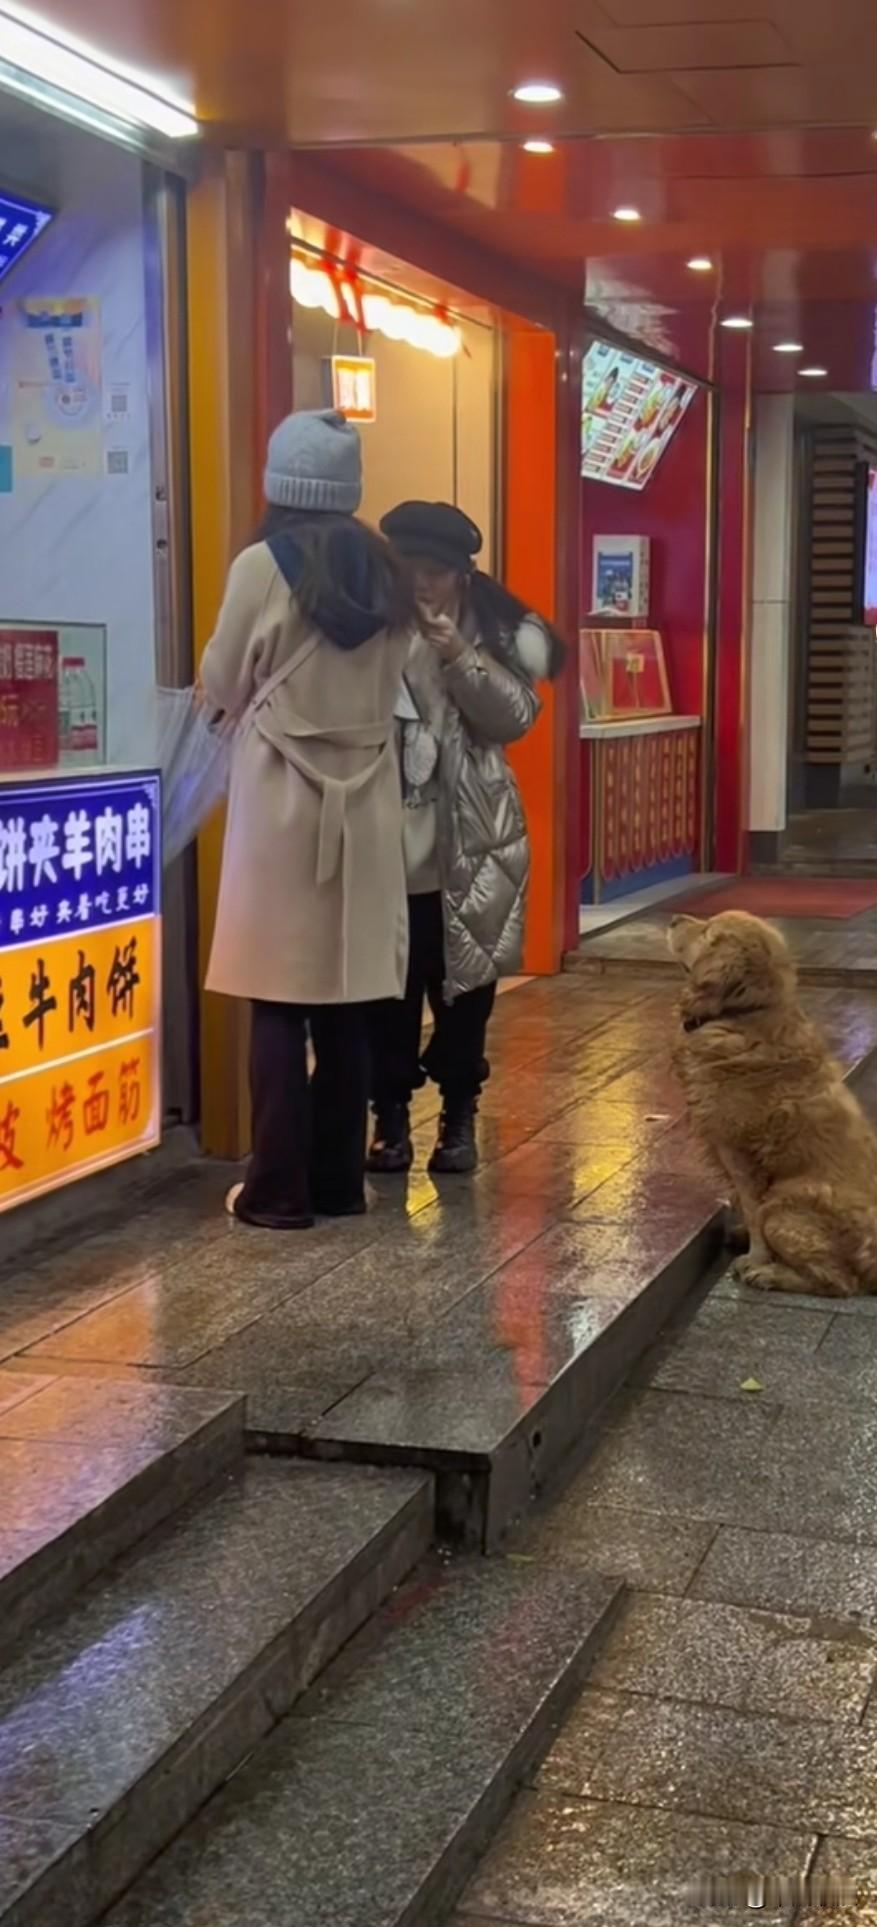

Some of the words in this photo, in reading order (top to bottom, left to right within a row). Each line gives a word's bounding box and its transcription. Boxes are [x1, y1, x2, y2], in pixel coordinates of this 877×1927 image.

[0, 802, 151, 894] 饼夹羊肉串
[0, 884, 151, 937] 串好夹着吃更好
[0, 935, 140, 1051] 牛肉饼
[46, 1058, 140, 1152] 烤面筋
